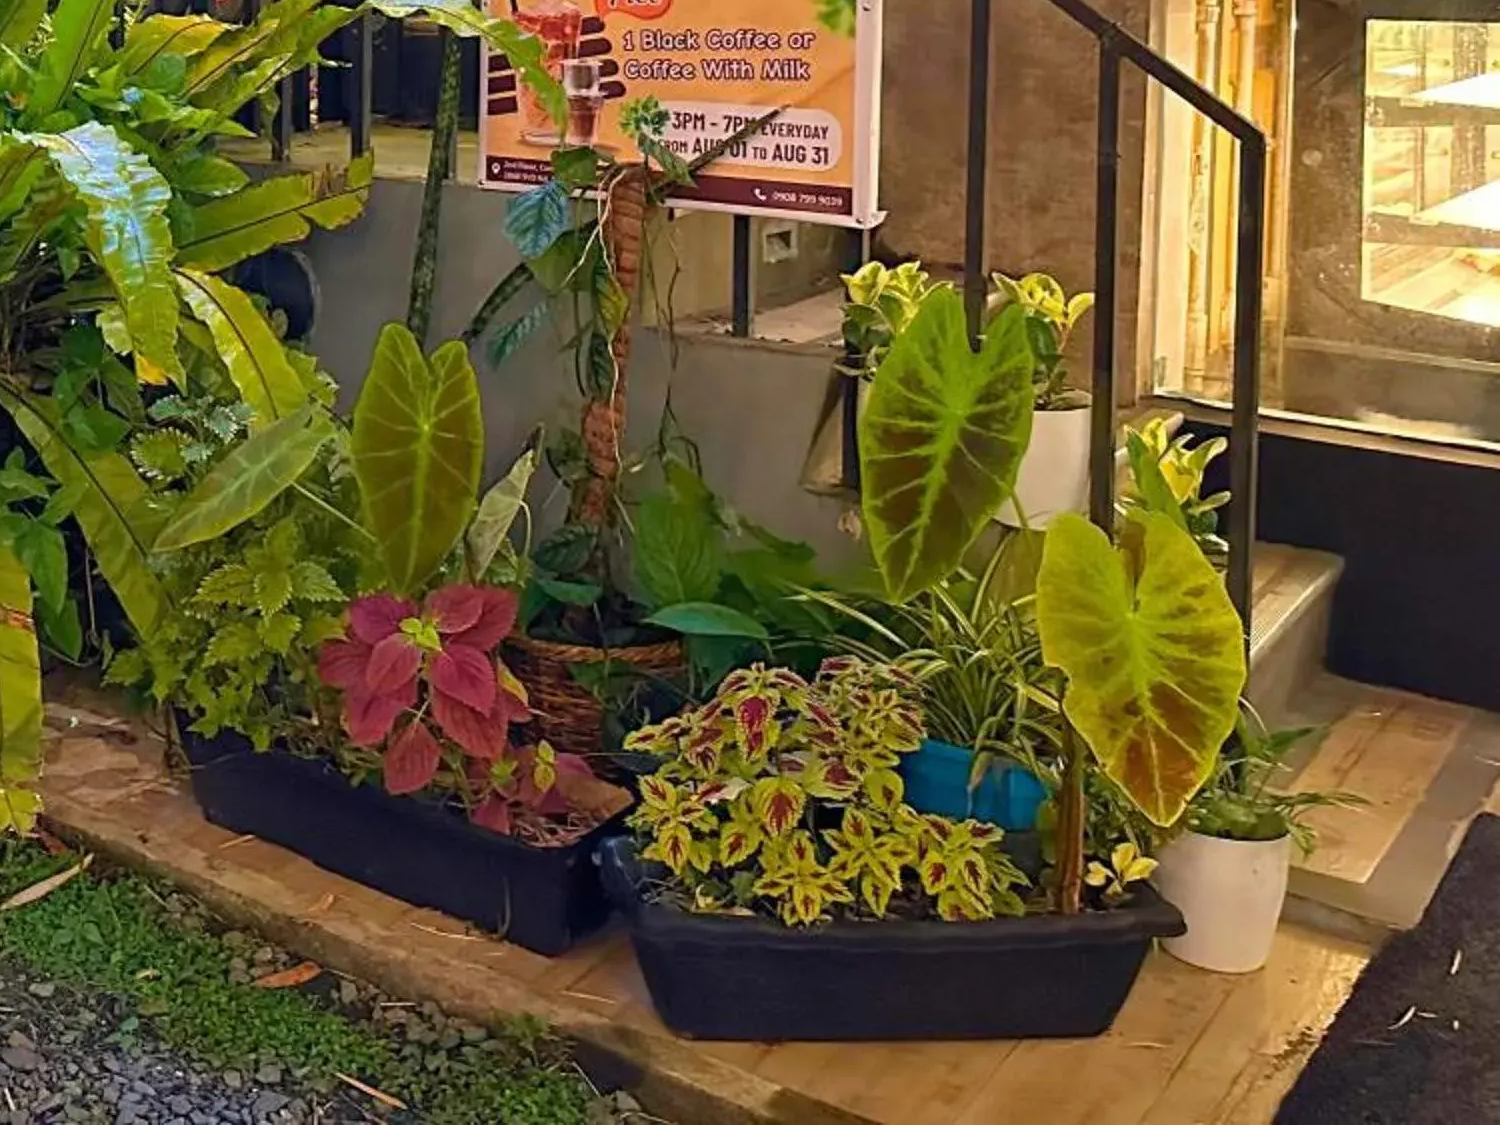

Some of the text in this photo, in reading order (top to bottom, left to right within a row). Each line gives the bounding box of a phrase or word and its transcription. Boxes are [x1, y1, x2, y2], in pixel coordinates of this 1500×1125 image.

[622, 28, 817, 52] 1 Black Coffee or
[624, 58, 812, 81] Coffee With Milk
[671, 111, 707, 132] 3PM
[762, 121, 831, 141] EVERYDAY
[729, 141, 749, 160] 01
[753, 145, 768, 160] TO
[771, 144, 807, 165] AUG
[811, 146, 830, 166] 31
